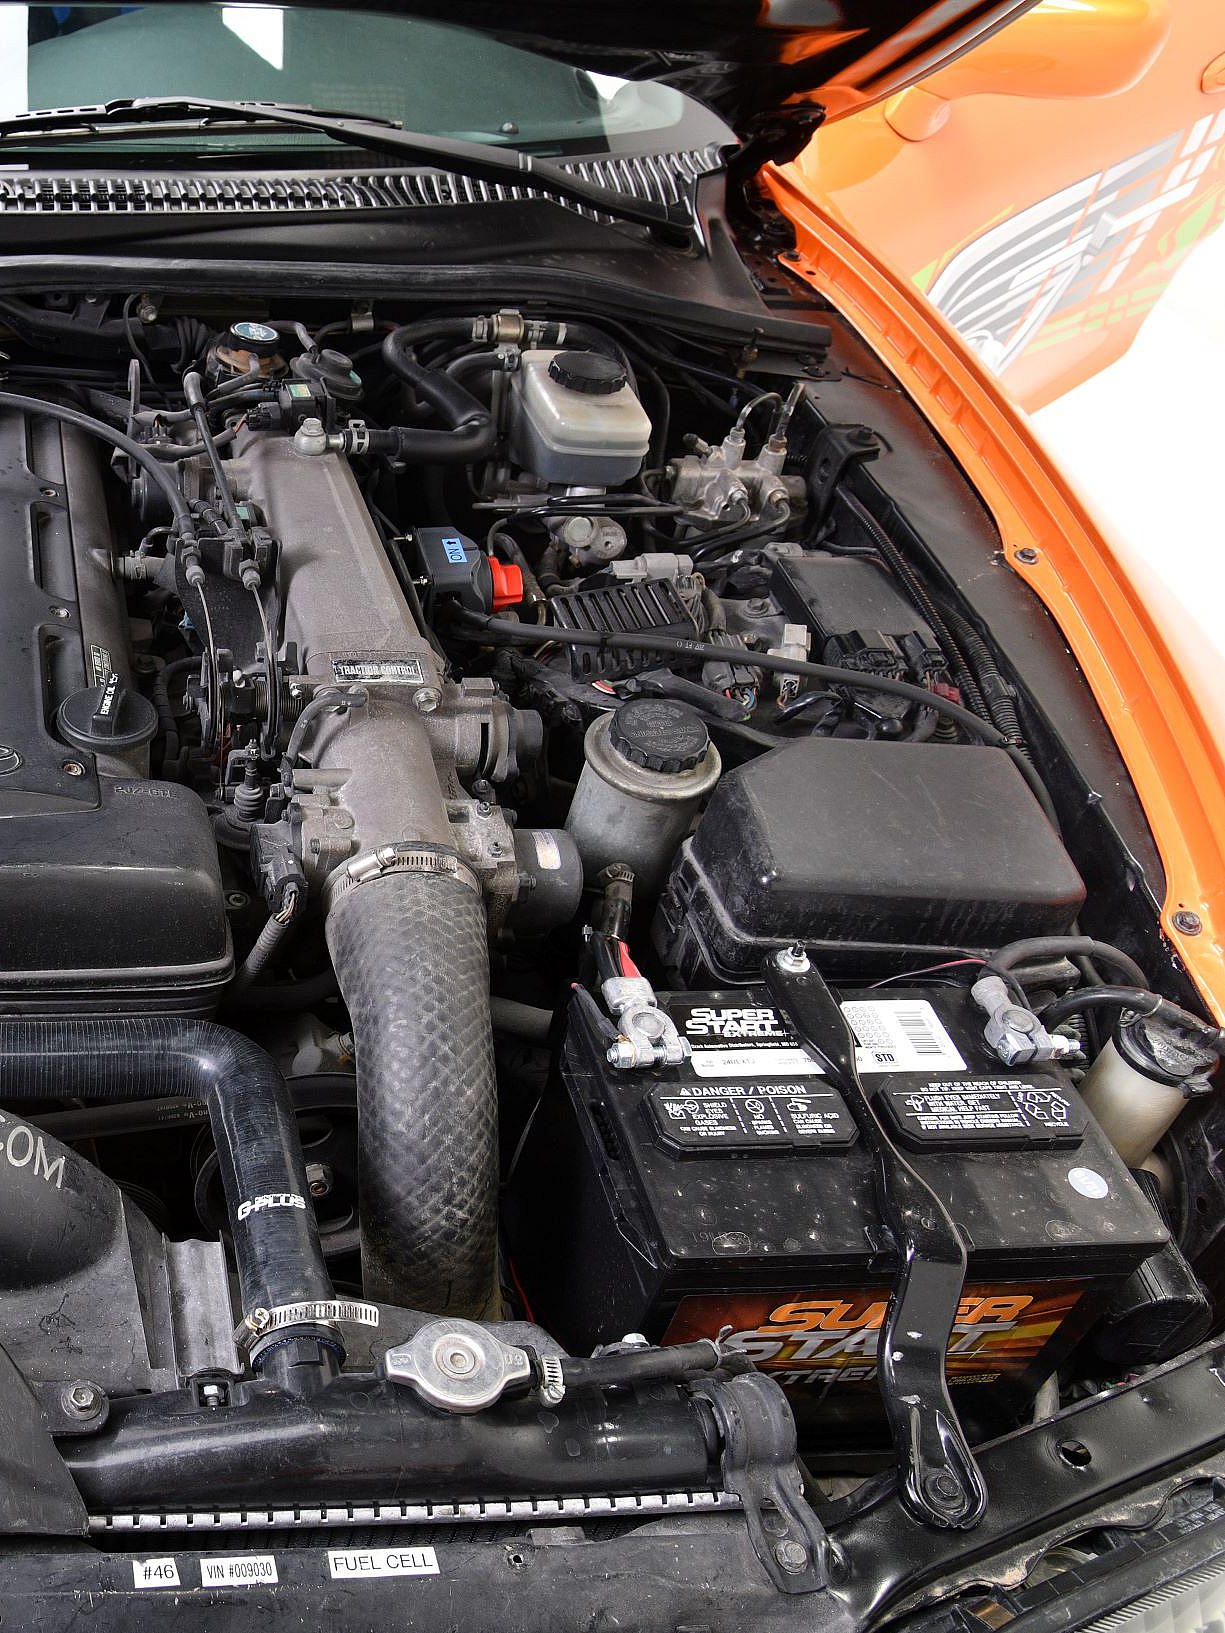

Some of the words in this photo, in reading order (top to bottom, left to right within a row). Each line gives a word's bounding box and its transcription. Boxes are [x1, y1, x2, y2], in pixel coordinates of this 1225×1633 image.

[448, 548, 463, 560] ON
[691, 1007, 775, 1020] SUPER
[685, 1019, 779, 1035] START
[876, 1053, 895, 1063] STD
[691, 1086, 746, 1096] DANGER
[756, 1084, 807, 1095] POISON
[758, 1295, 1034, 1333] SUER
[724, 1320, 1019, 1362] STAT
[333, 1556, 382, 1572] FUEL
[386, 1552, 434, 1569] CELL
[143, 1564, 175, 1580] #46
[206, 1564, 224, 1580] VIN
[229, 1561, 273, 1578] #009030
